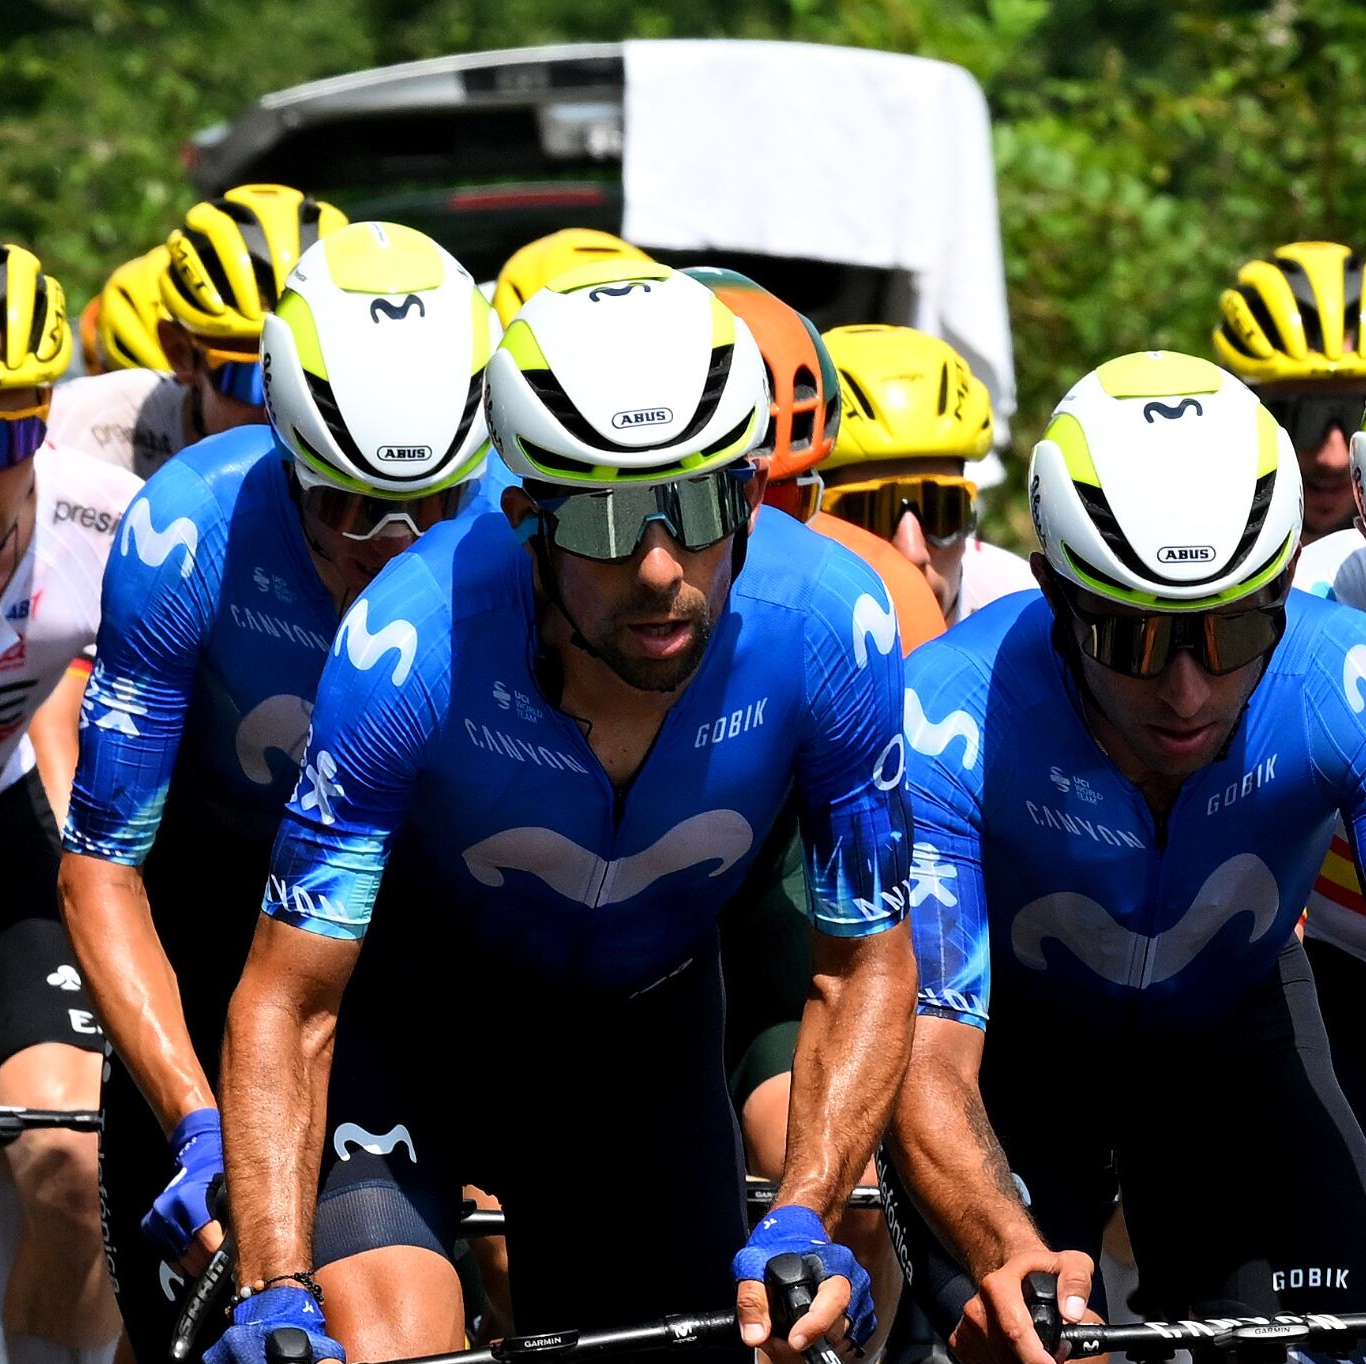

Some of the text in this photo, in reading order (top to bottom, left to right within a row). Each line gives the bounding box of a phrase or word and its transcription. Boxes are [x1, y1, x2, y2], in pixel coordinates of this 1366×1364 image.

[173, 240, 206, 291] MET
[620, 411, 667, 426] ABUS
[384, 449, 426, 460] ABUS
[1165, 549, 1210, 561] ABUS
[694, 697, 768, 748] GOBIK
[464, 717, 589, 775] CANYON
[1073, 776, 1090, 788] UCI
[1206, 754, 1279, 817] GOBIK
[1026, 800, 1146, 850] CANYON
[1273, 1268, 1349, 1292] GOBIK
[177, 1251, 230, 1338] SRAM
[524, 1337, 562, 1348] GARMIN
[1254, 1326, 1291, 1336] GARMIN
